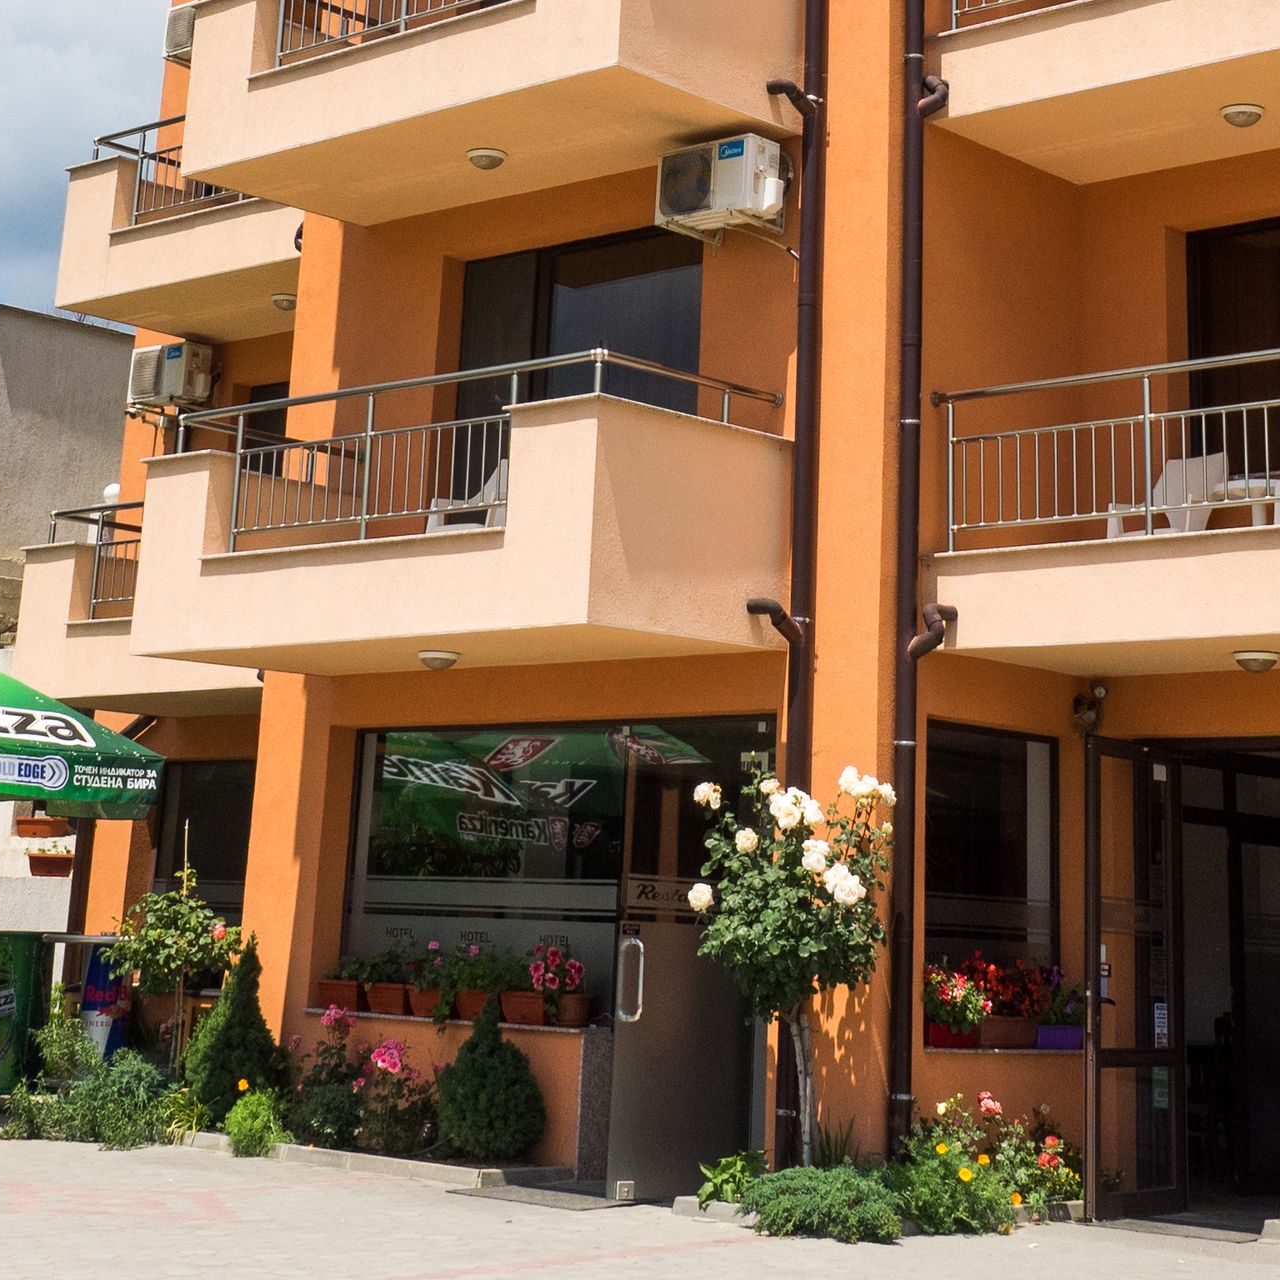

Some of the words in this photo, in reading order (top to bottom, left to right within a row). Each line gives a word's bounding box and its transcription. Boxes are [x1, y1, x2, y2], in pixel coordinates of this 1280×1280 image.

[17, 759, 47, 781] EDGE
[74, 765, 99, 775] ТОЧЕН
[146, 769, 158, 779] ЗА
[73, 774, 123, 789] СТУДЕНА
[127, 777, 157, 791] БИРА
[460, 930, 492, 944] HOTEL
